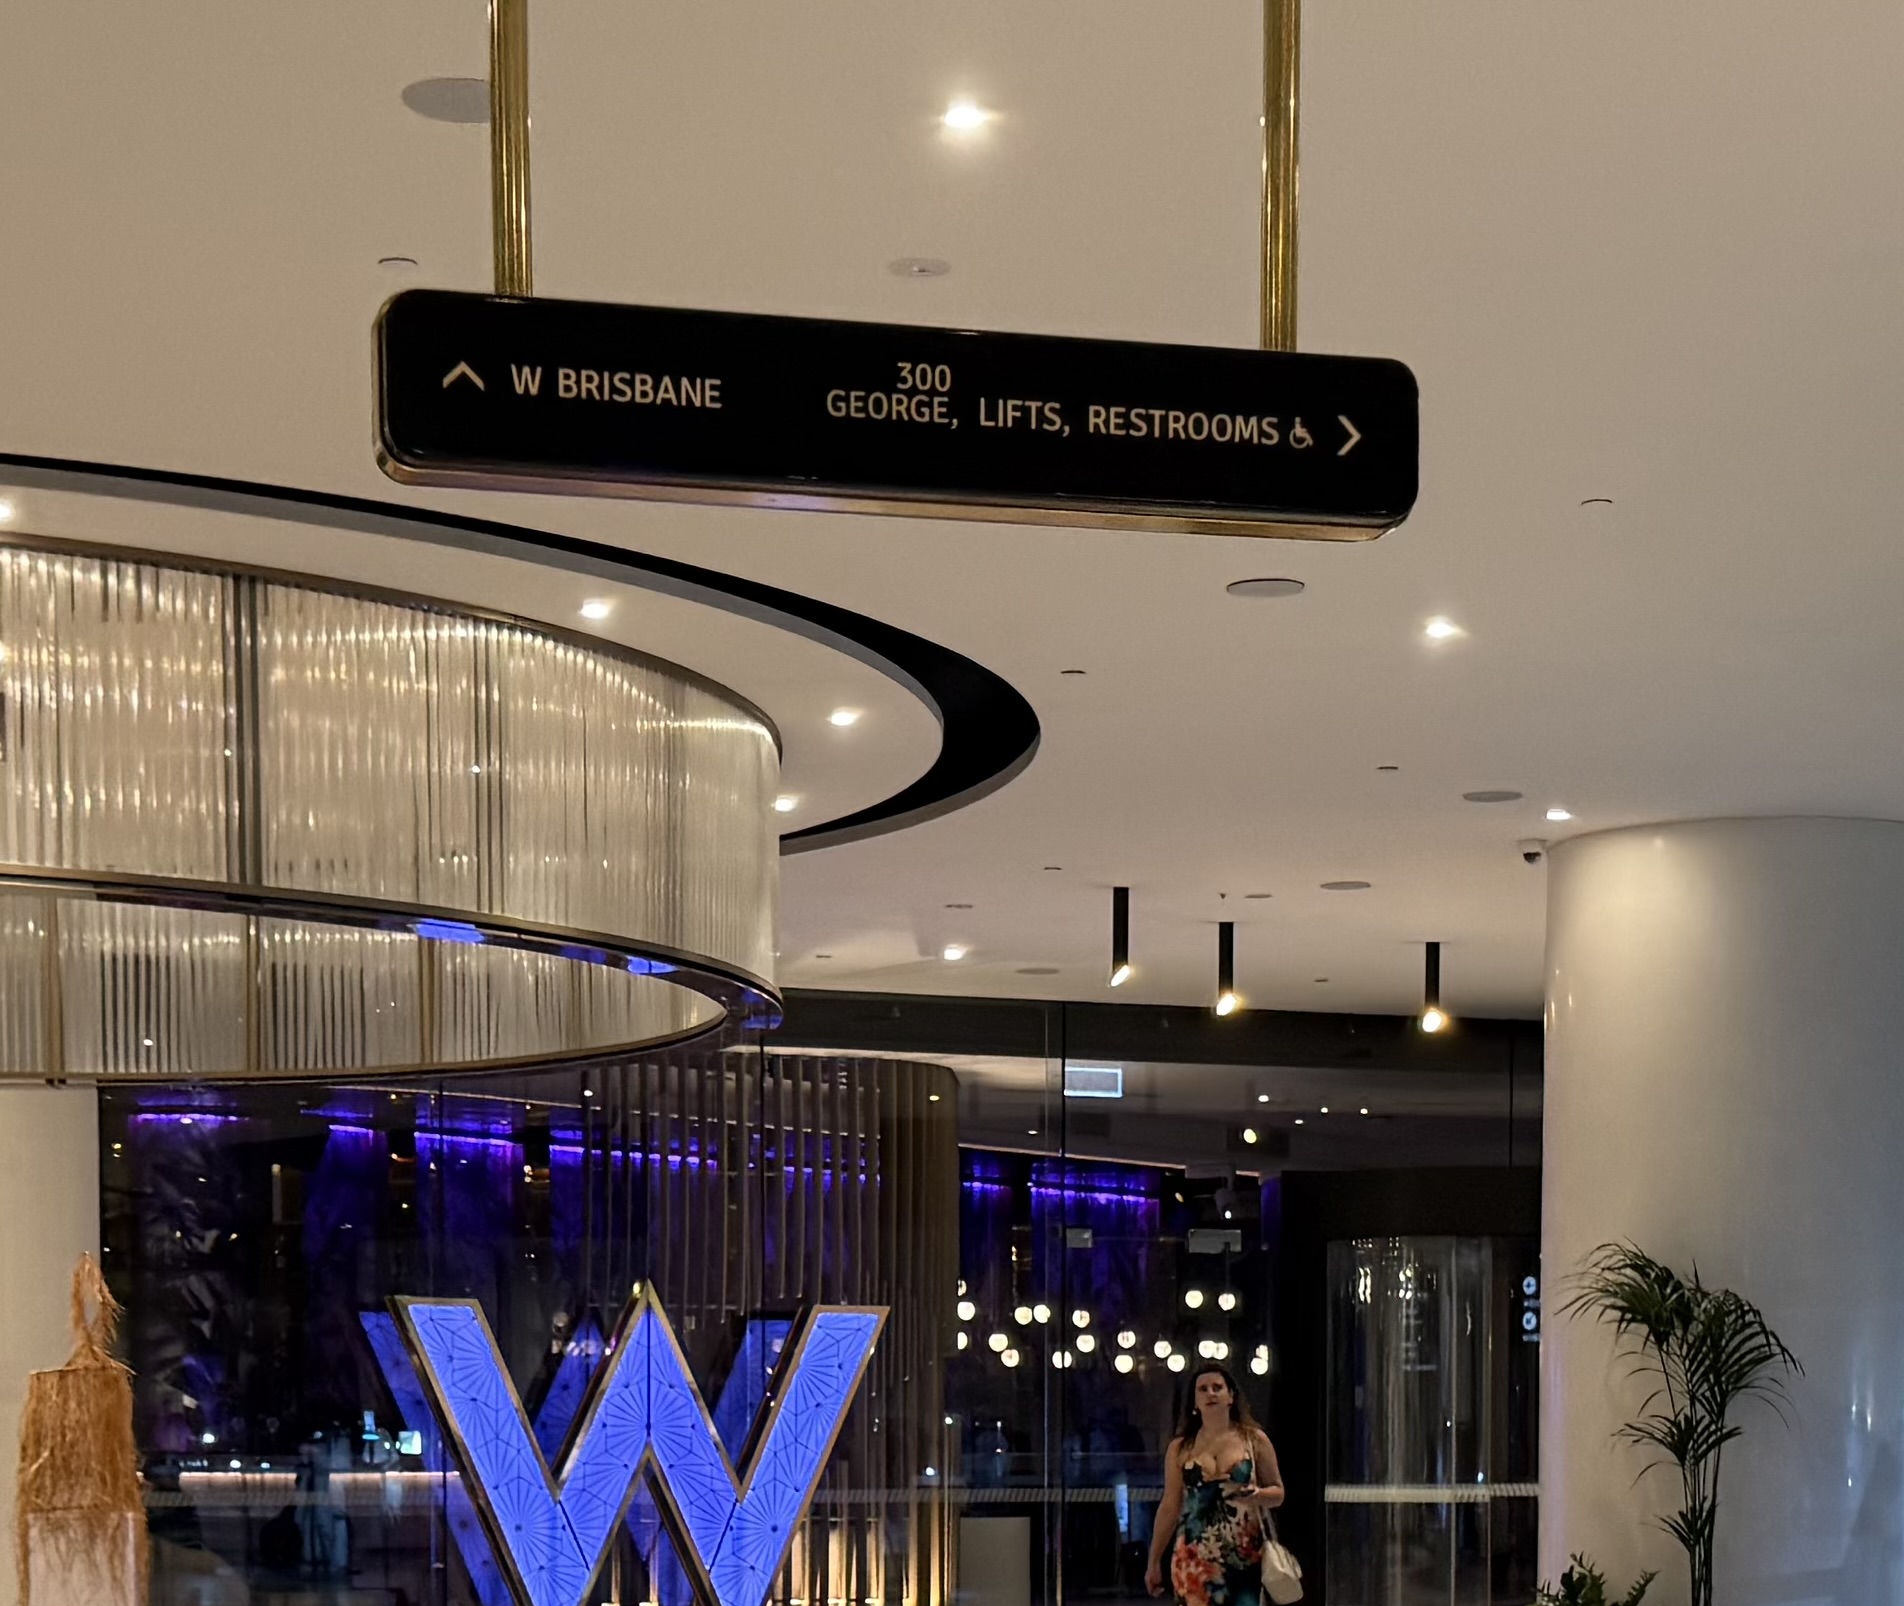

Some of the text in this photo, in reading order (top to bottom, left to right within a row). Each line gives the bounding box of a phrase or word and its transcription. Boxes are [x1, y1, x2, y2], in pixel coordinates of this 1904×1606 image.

[510, 363, 723, 409] W BRISBANE
[896, 362, 952, 393] 300
[827, 389, 1281, 446] GEORGE, LIFTS, RESTROOMS
